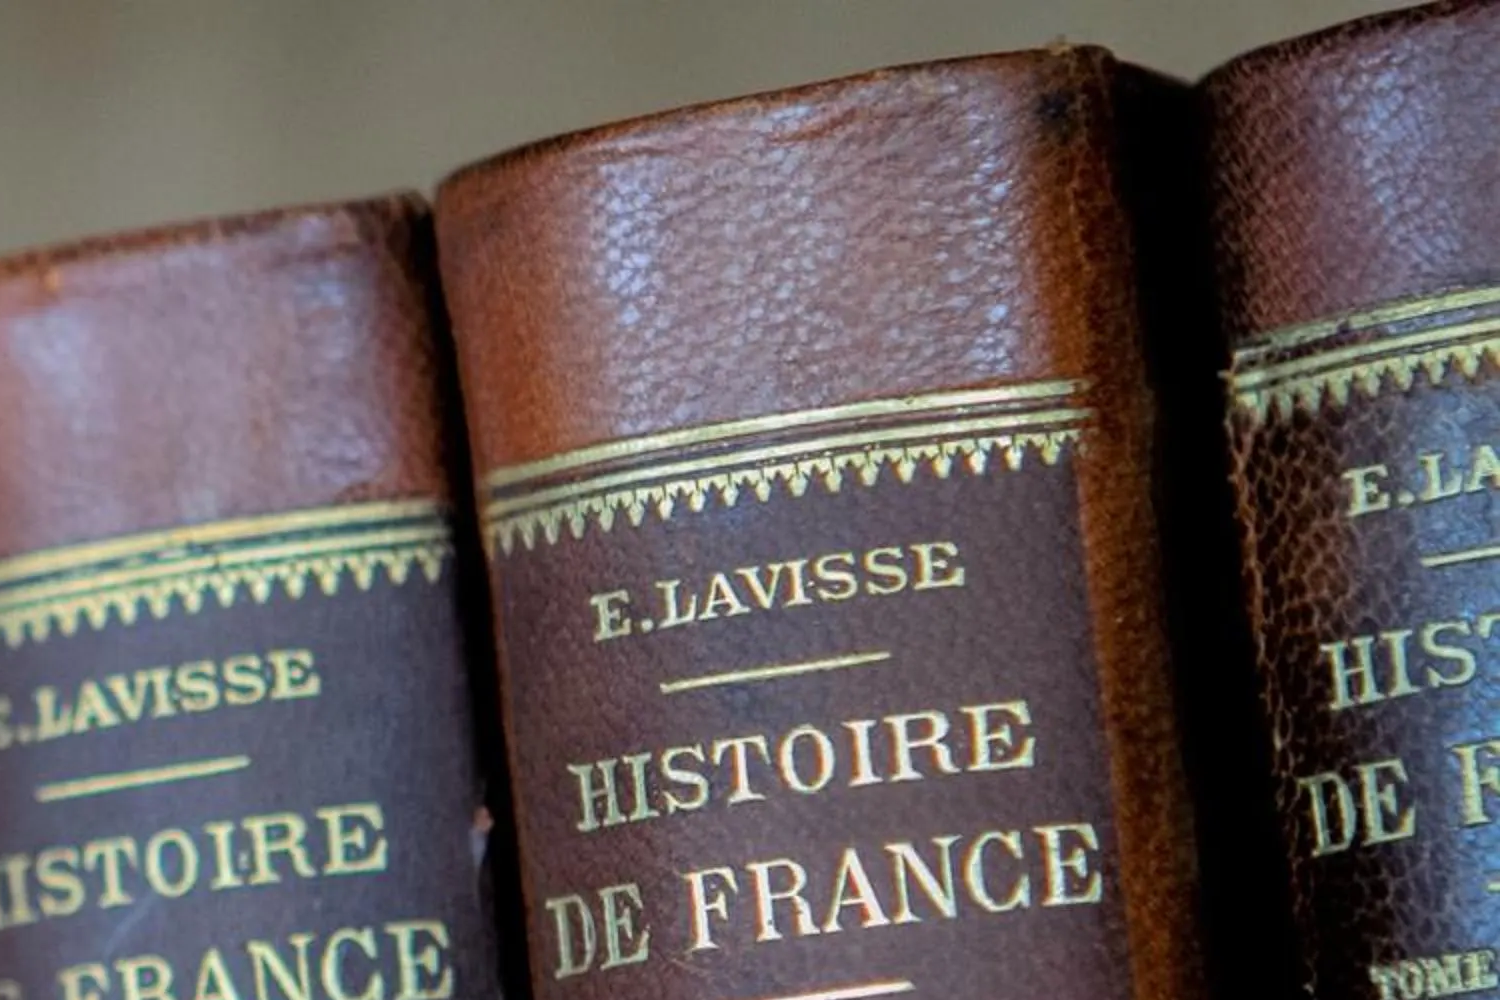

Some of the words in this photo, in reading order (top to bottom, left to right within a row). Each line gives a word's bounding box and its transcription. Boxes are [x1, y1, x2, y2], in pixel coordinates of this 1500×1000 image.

[590, 542, 966, 641] E.LAVISSE
[567, 701, 1036, 831] HISTOIRE
[1299, 759, 1416, 858] DE
[545, 883, 651, 980] DE
[682, 822, 1103, 955] FRANCE
